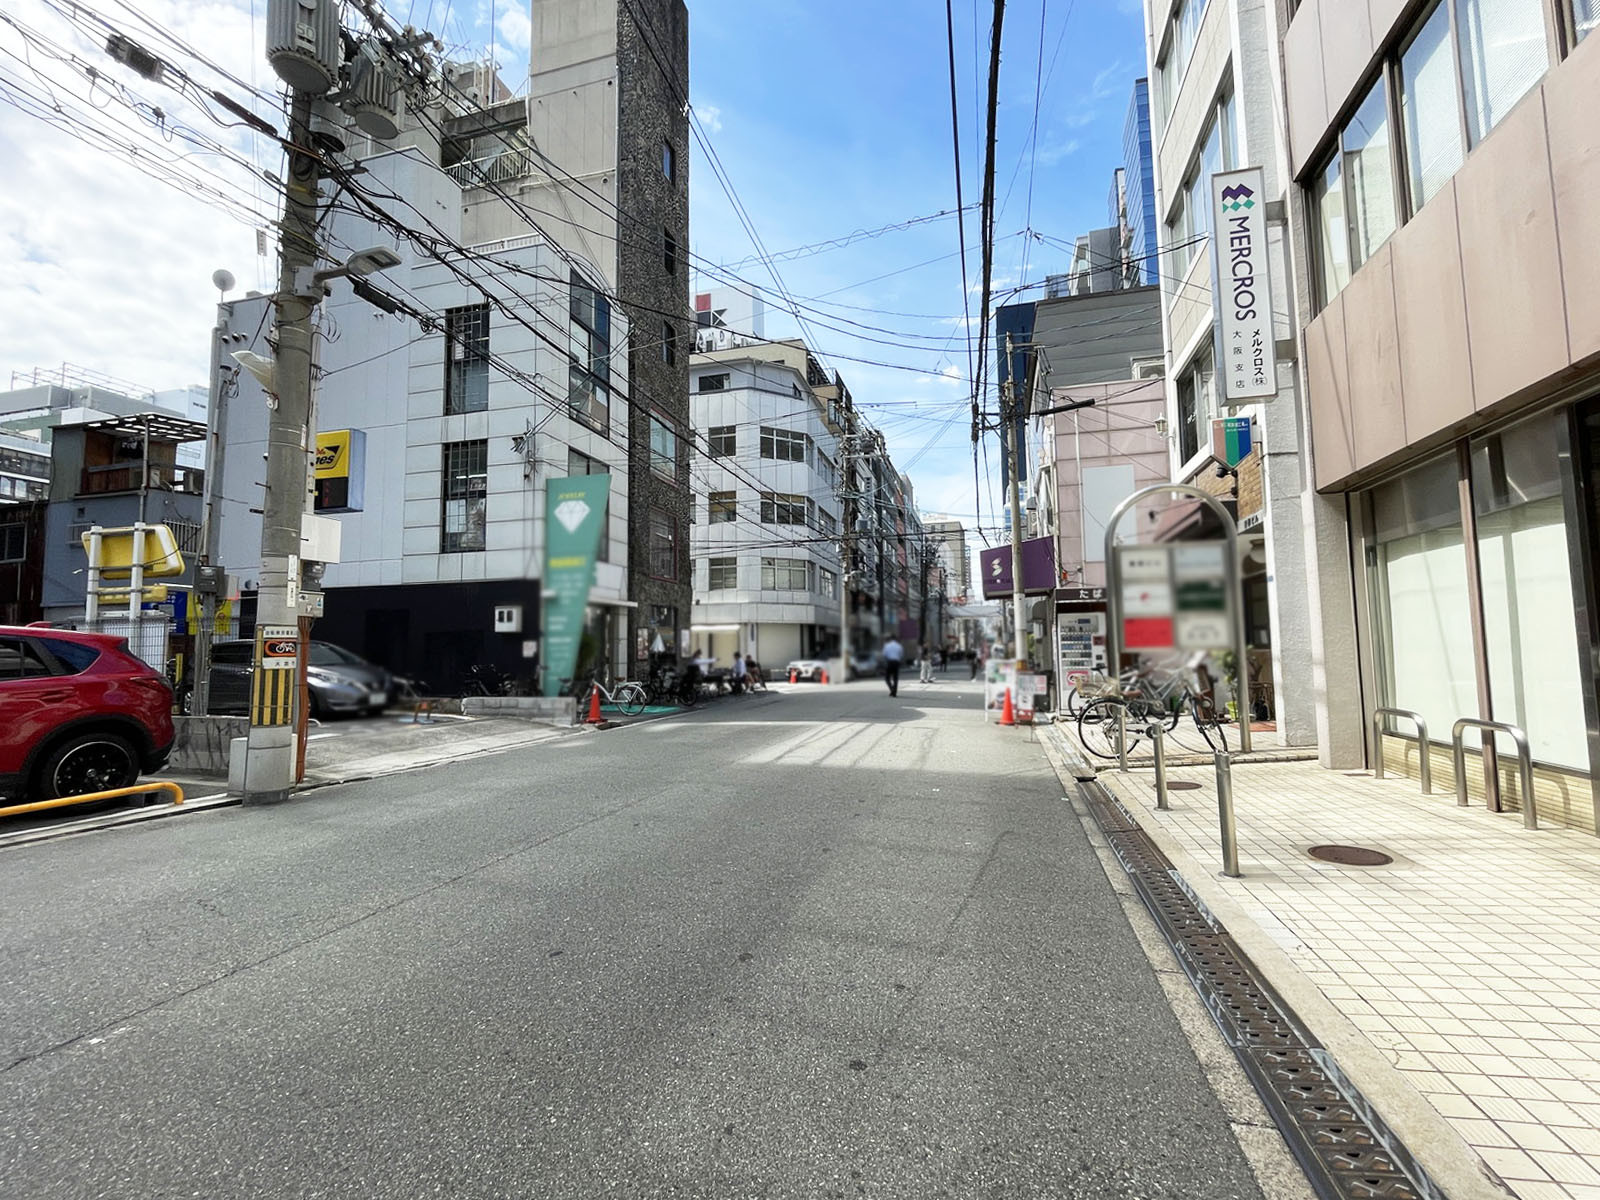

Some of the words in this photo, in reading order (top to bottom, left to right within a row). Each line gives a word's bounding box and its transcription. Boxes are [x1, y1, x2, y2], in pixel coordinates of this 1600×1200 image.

[1229, 216, 1257, 321] MERCROS
[1233, 330, 1245, 388] 大阪支店
